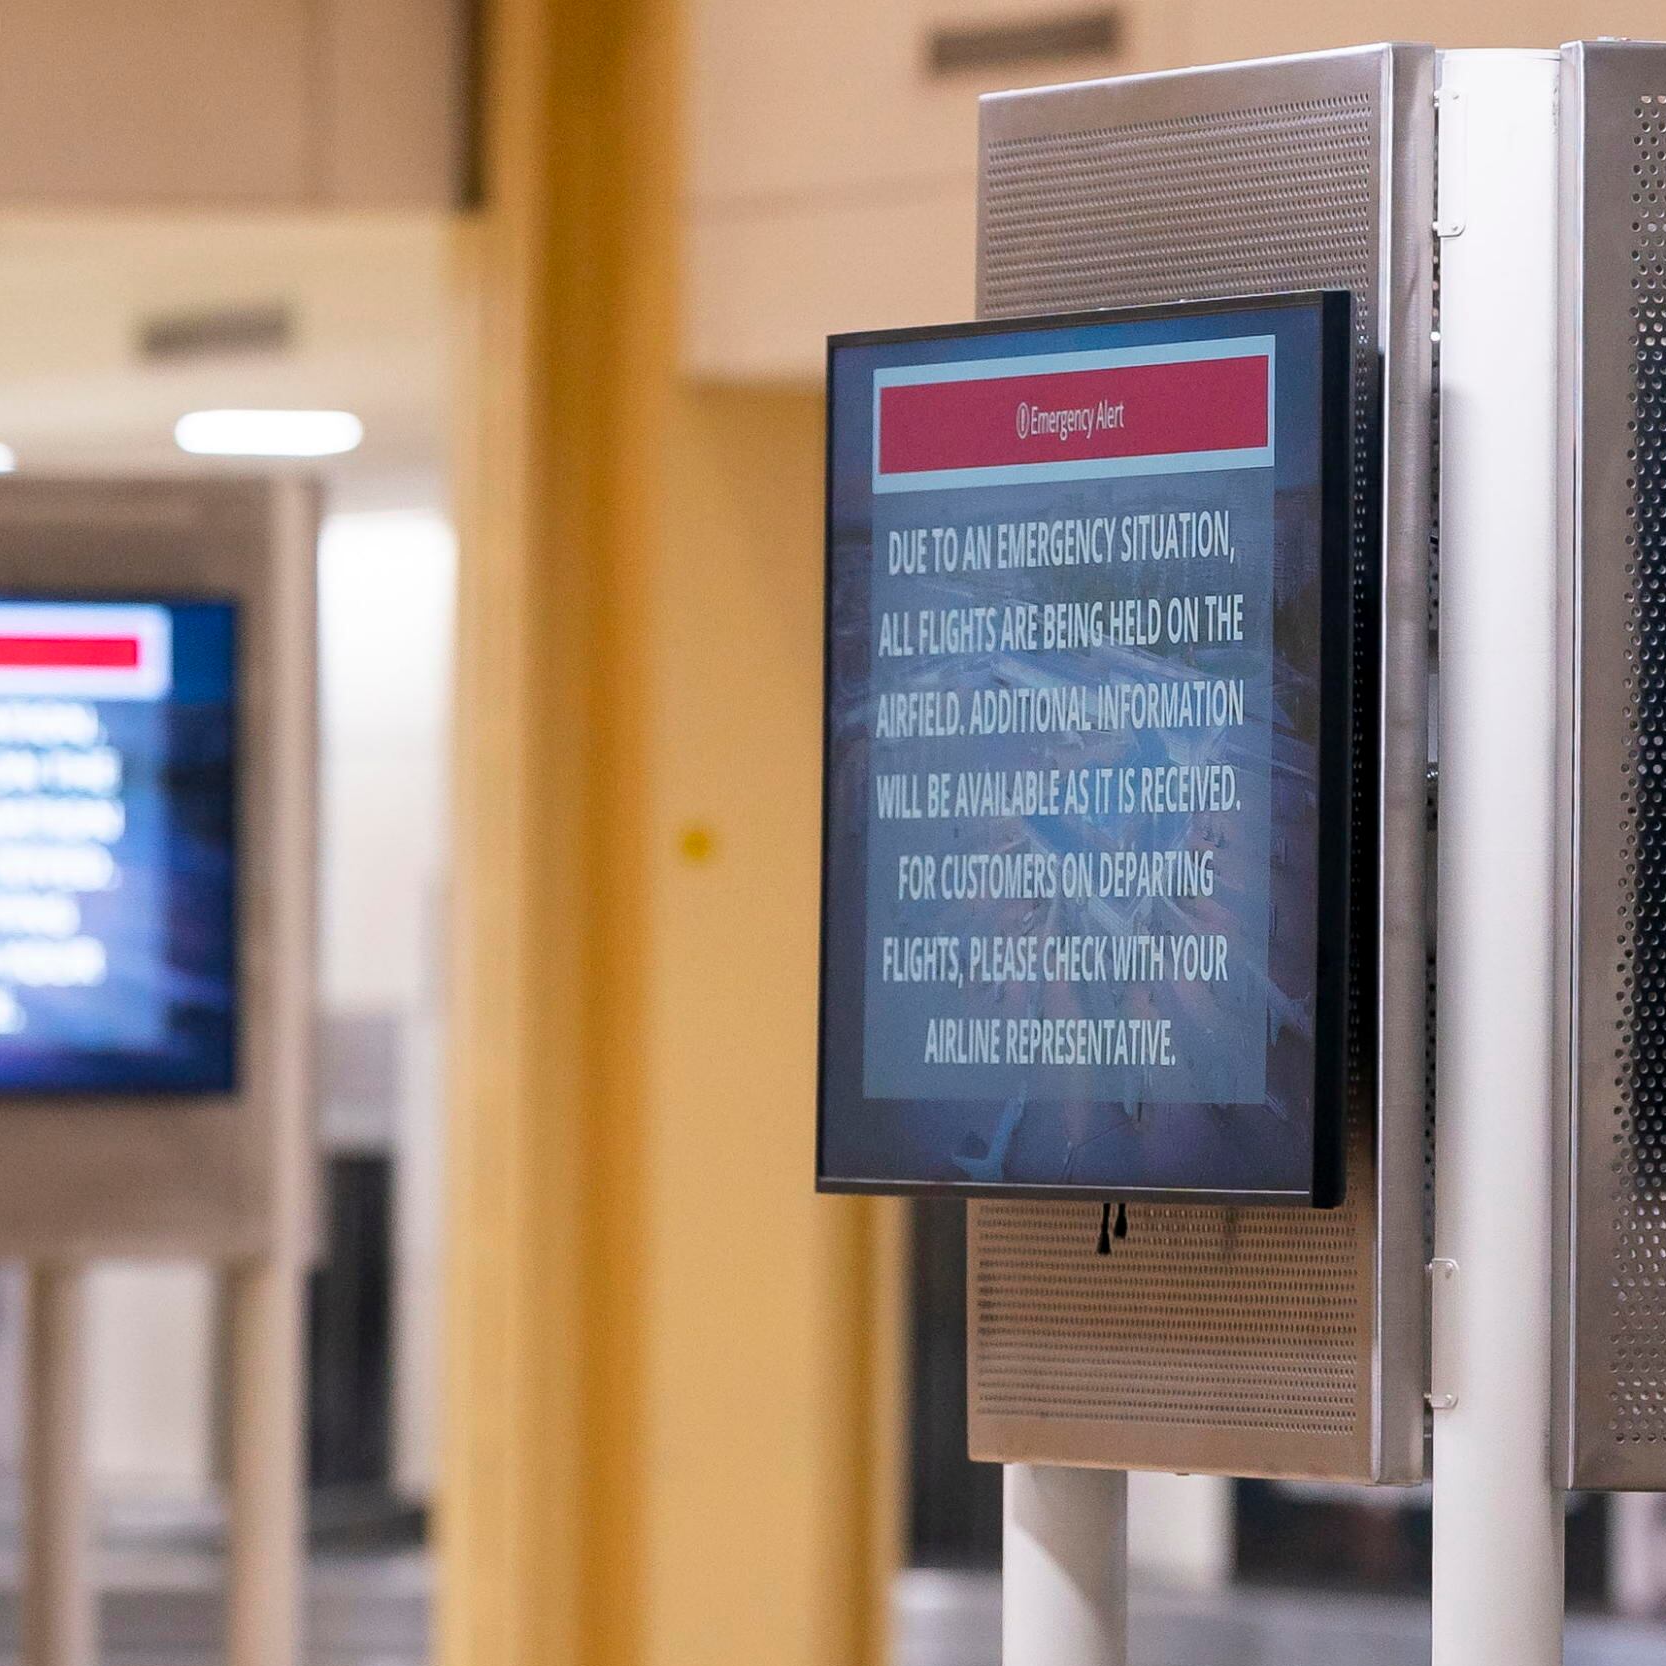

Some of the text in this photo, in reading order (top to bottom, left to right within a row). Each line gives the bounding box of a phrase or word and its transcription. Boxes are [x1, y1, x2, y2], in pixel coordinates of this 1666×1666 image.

[1031, 400, 1124, 440] Emergency Alert
[889, 511, 1234, 575] DUE TO AN EMERGENCY SITUATION,
[879, 595, 1243, 656] ALL FLIGHTS ARE BEING HELD ON THE
[876, 679, 1244, 738] AIRFIELD. ADDITIONAL INFORMATION
[877, 765, 1240, 819] WILL BE AVAILABLE AS IT IS RECEIVED.
[899, 850, 1213, 900] FOR CUSTOMERS ON DEPARTING
[883, 935, 1227, 988] FLIGHTS, PLEASE CHECK WITH YOUR
[925, 1019, 1175, 1065] AIRLINE REPRESENTATIVE.
